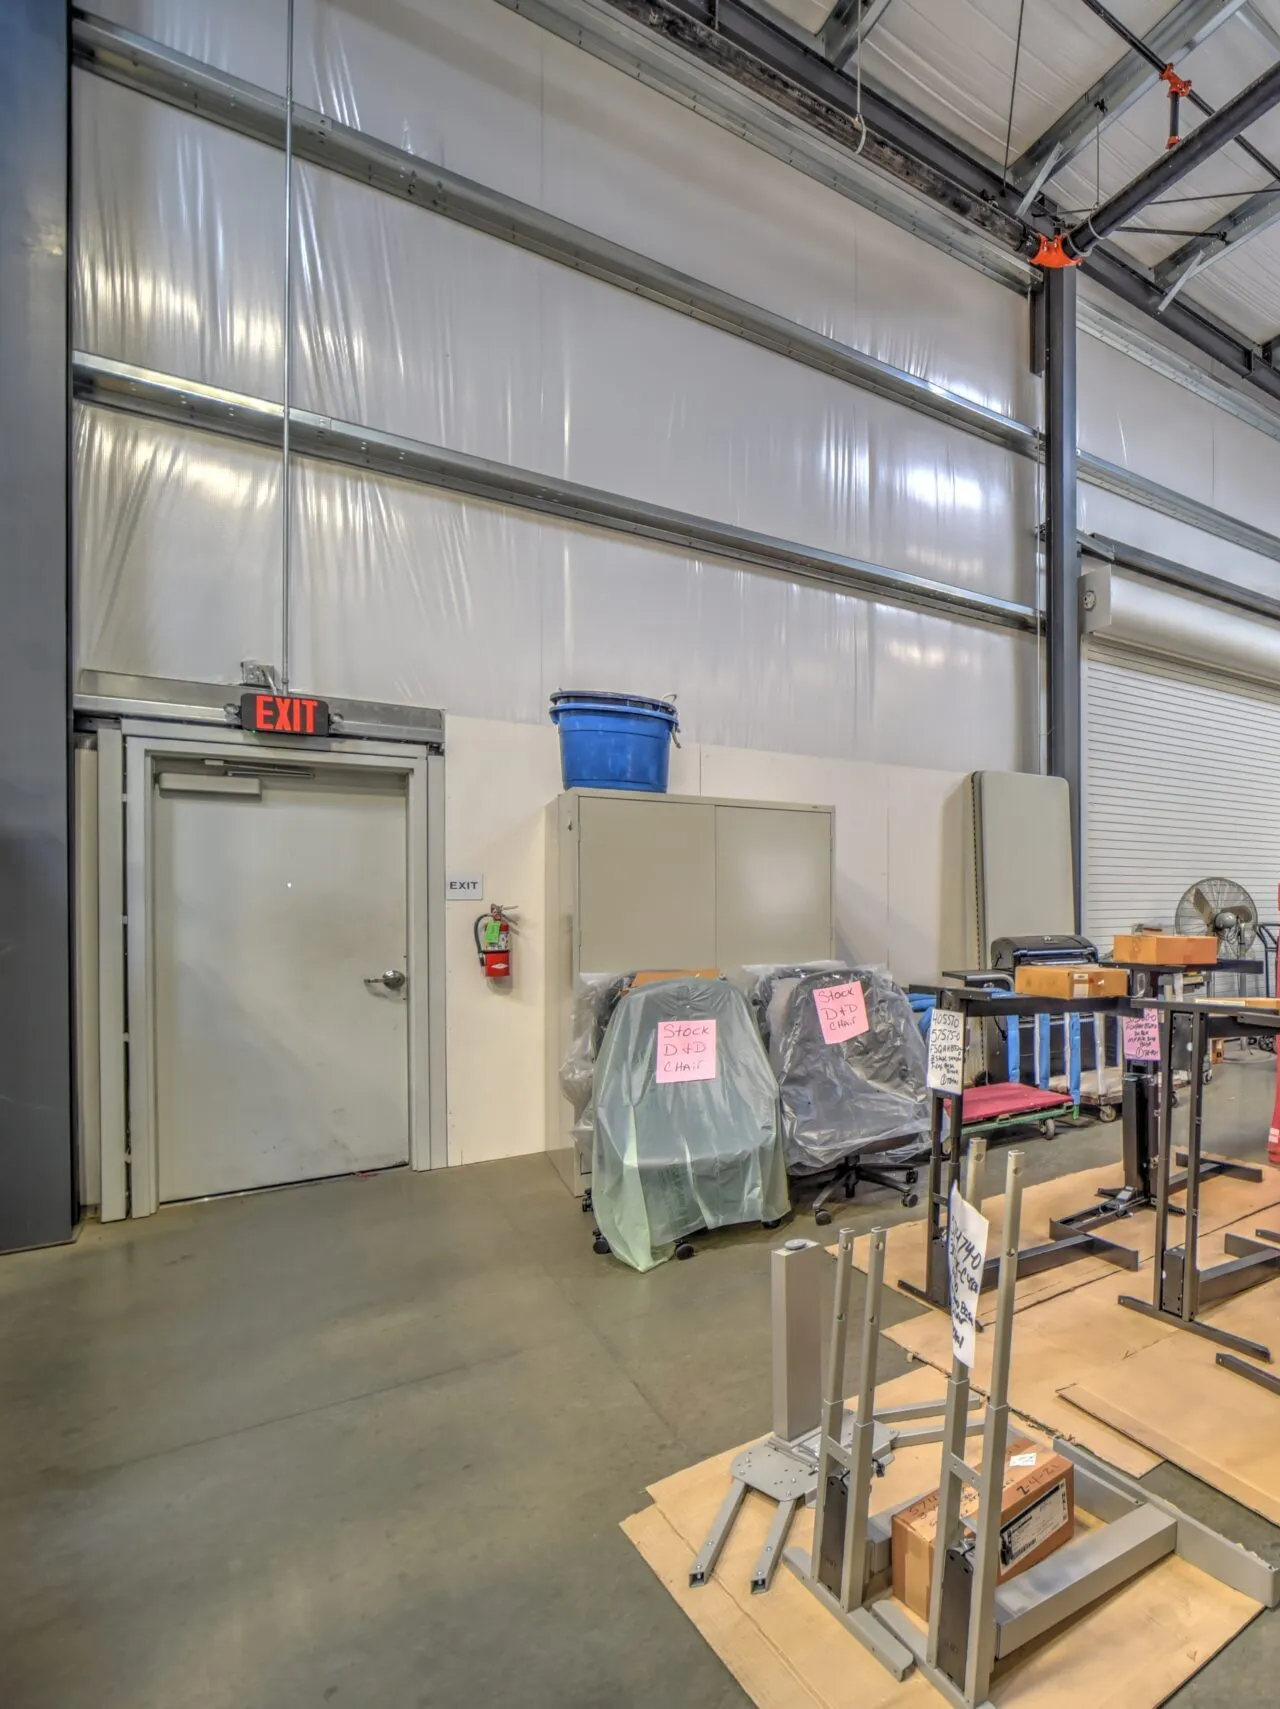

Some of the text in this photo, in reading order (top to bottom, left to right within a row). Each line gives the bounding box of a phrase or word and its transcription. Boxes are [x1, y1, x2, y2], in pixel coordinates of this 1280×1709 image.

[256, 695, 318, 733] EXIT
[449, 881, 478, 890] EXIT
[820, 1007, 838, 1020] D
[664, 1043, 678, 1056] D
[693, 1040, 706, 1053] D
